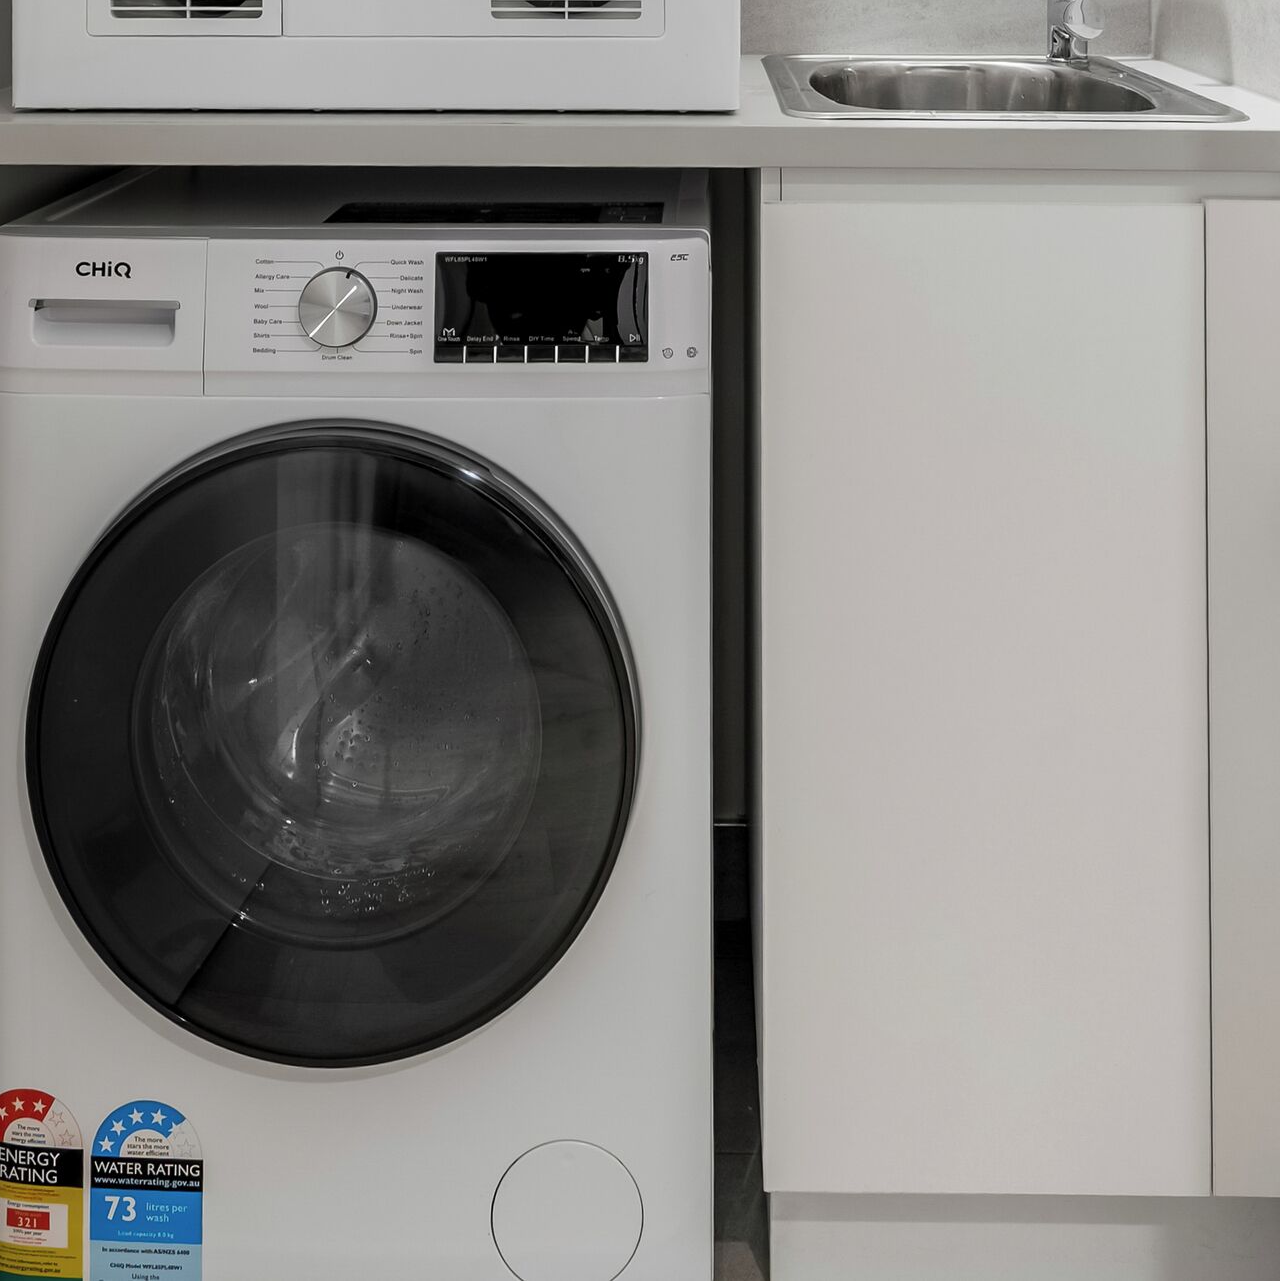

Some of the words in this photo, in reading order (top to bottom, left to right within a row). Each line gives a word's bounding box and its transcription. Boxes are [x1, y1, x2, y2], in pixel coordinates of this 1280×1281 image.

[75, 260, 132, 279] CHiQ
[0, 1164, 58, 1184] RATING
[94, 1160, 143, 1175] WATER
[147, 1162, 200, 1177] RATING
[94, 1177, 200, 1188] www.waterrating.gov.au
[104, 1195, 137, 1222] 73
[146, 1202, 170, 1212] litres
[172, 1205, 188, 1214] per
[17, 1216, 38, 1228] 321
[146, 1214, 169, 1223] wash
